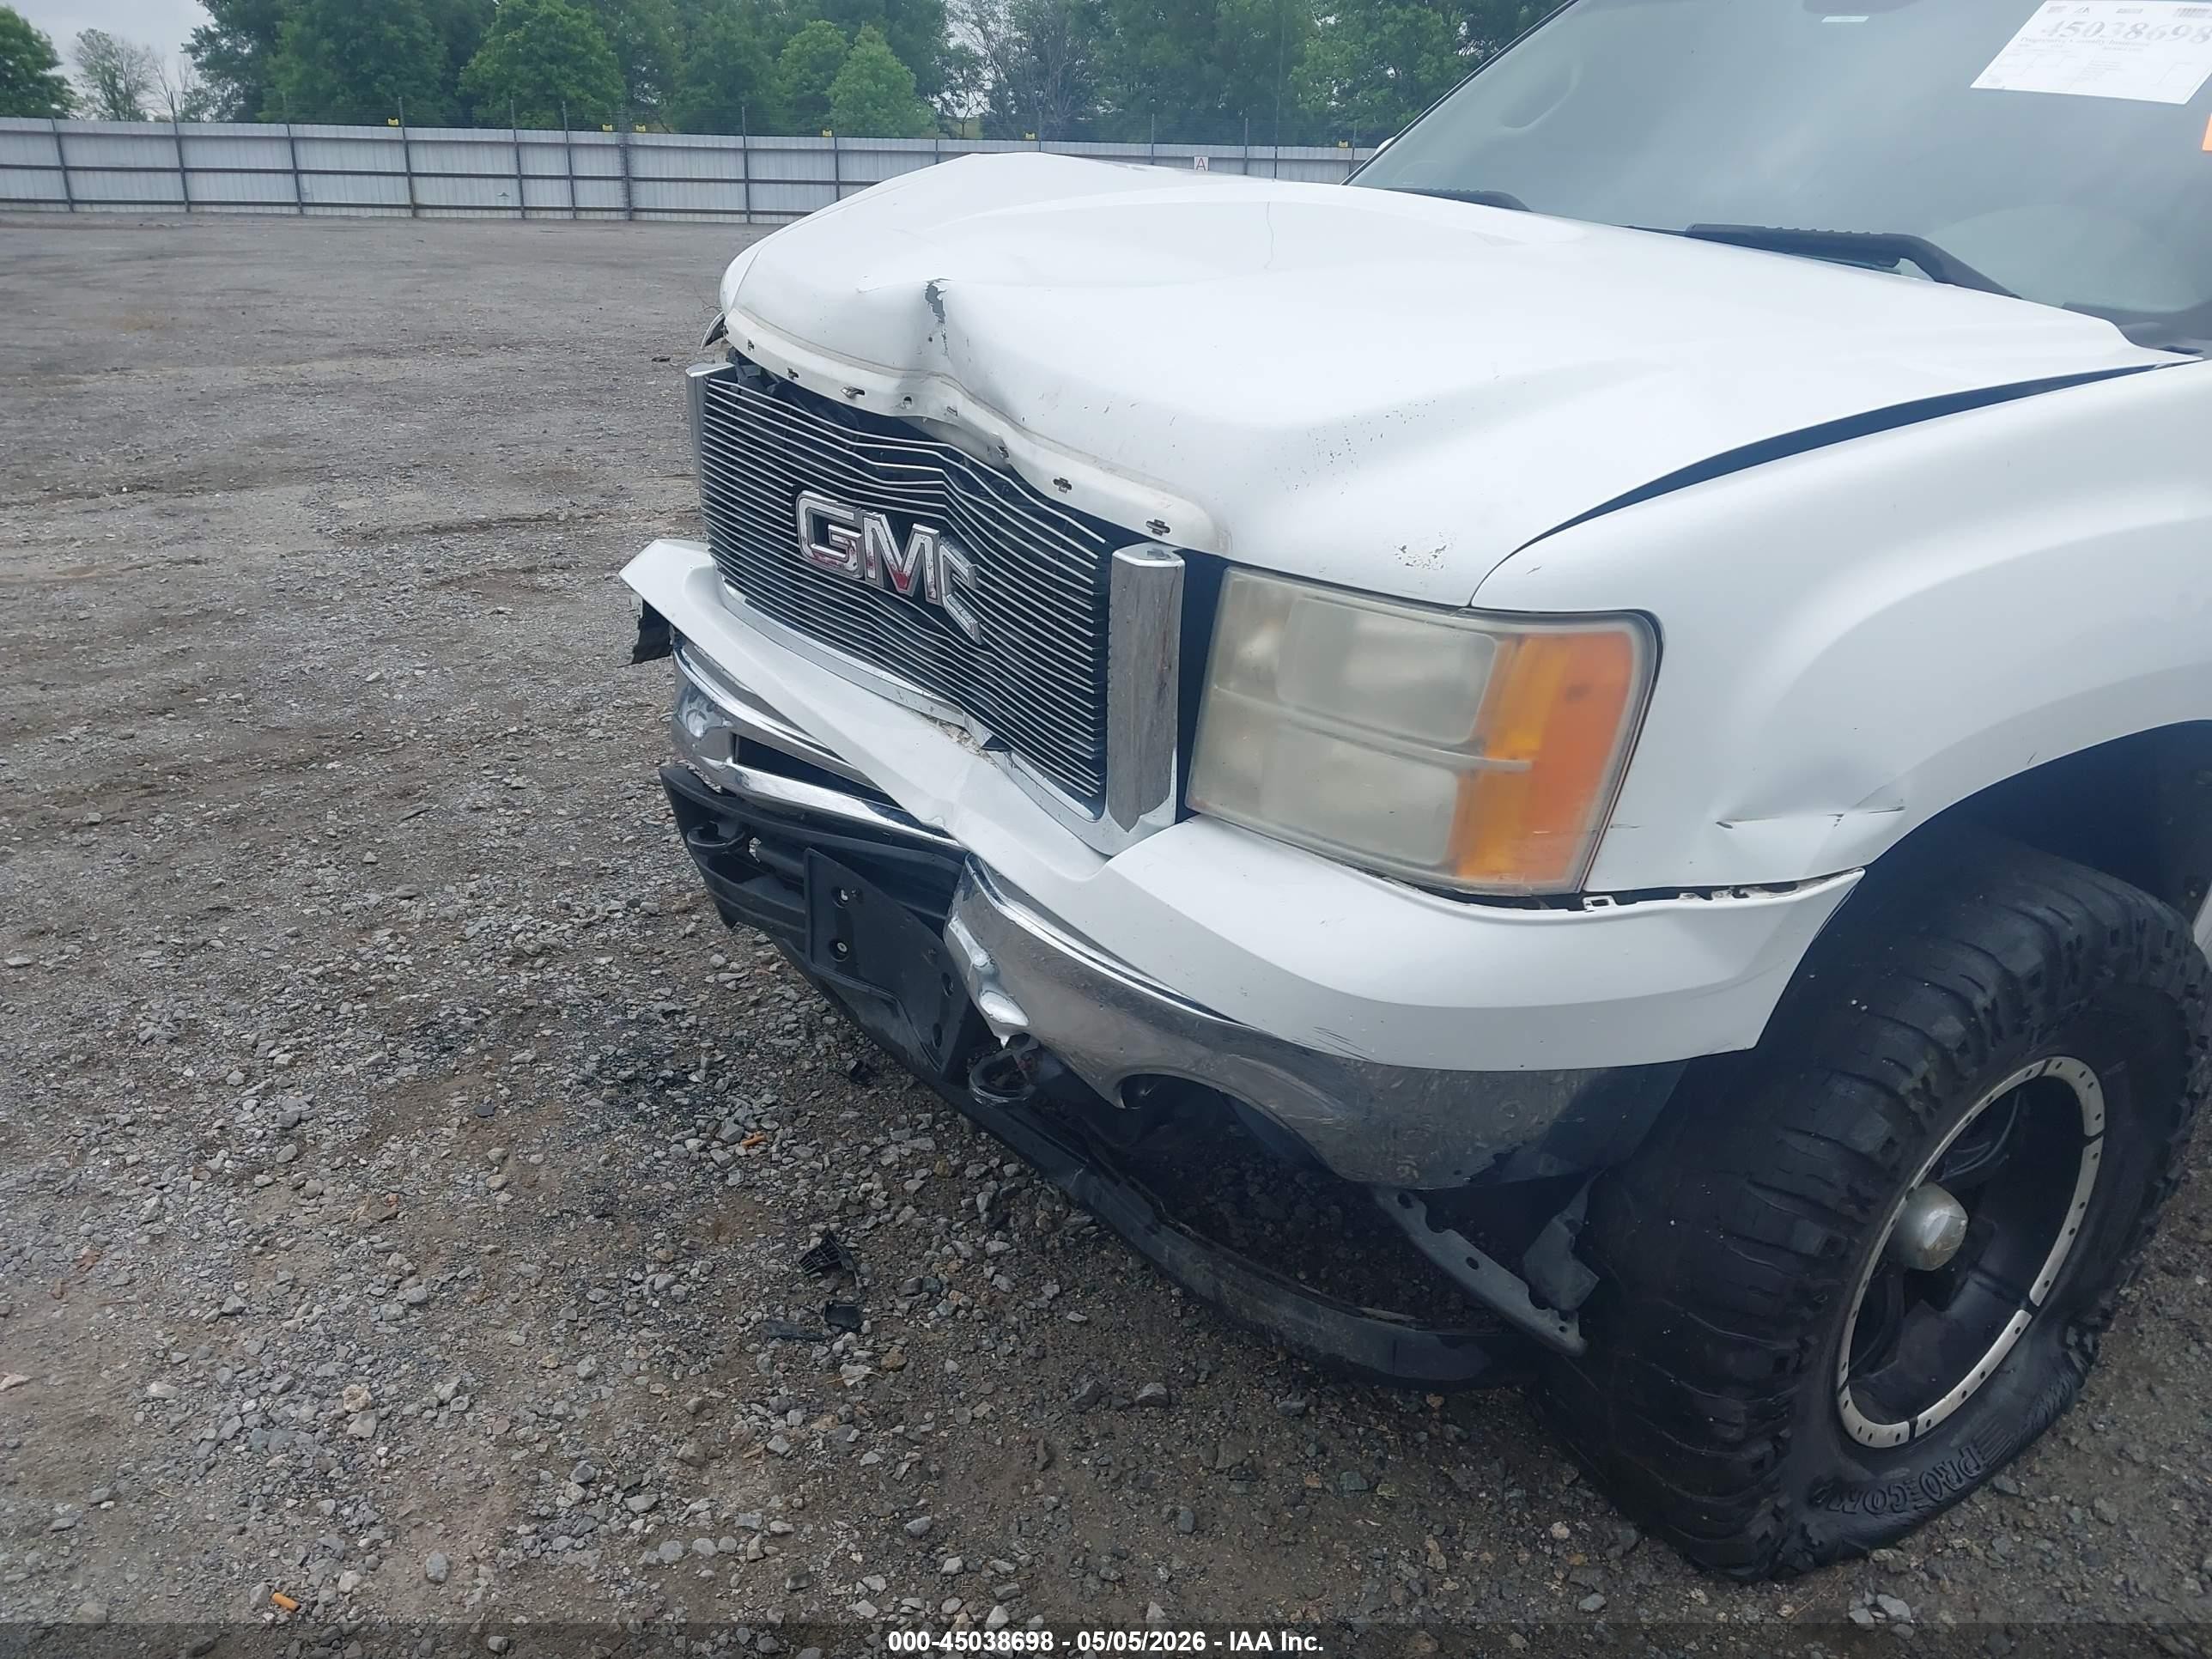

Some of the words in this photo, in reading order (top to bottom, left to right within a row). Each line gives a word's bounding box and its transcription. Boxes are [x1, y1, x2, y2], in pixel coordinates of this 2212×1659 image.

[1195, 157, 1206, 171] A
[795, 490, 982, 644] GMC
[1919, 1446, 1982, 1503] PRO
